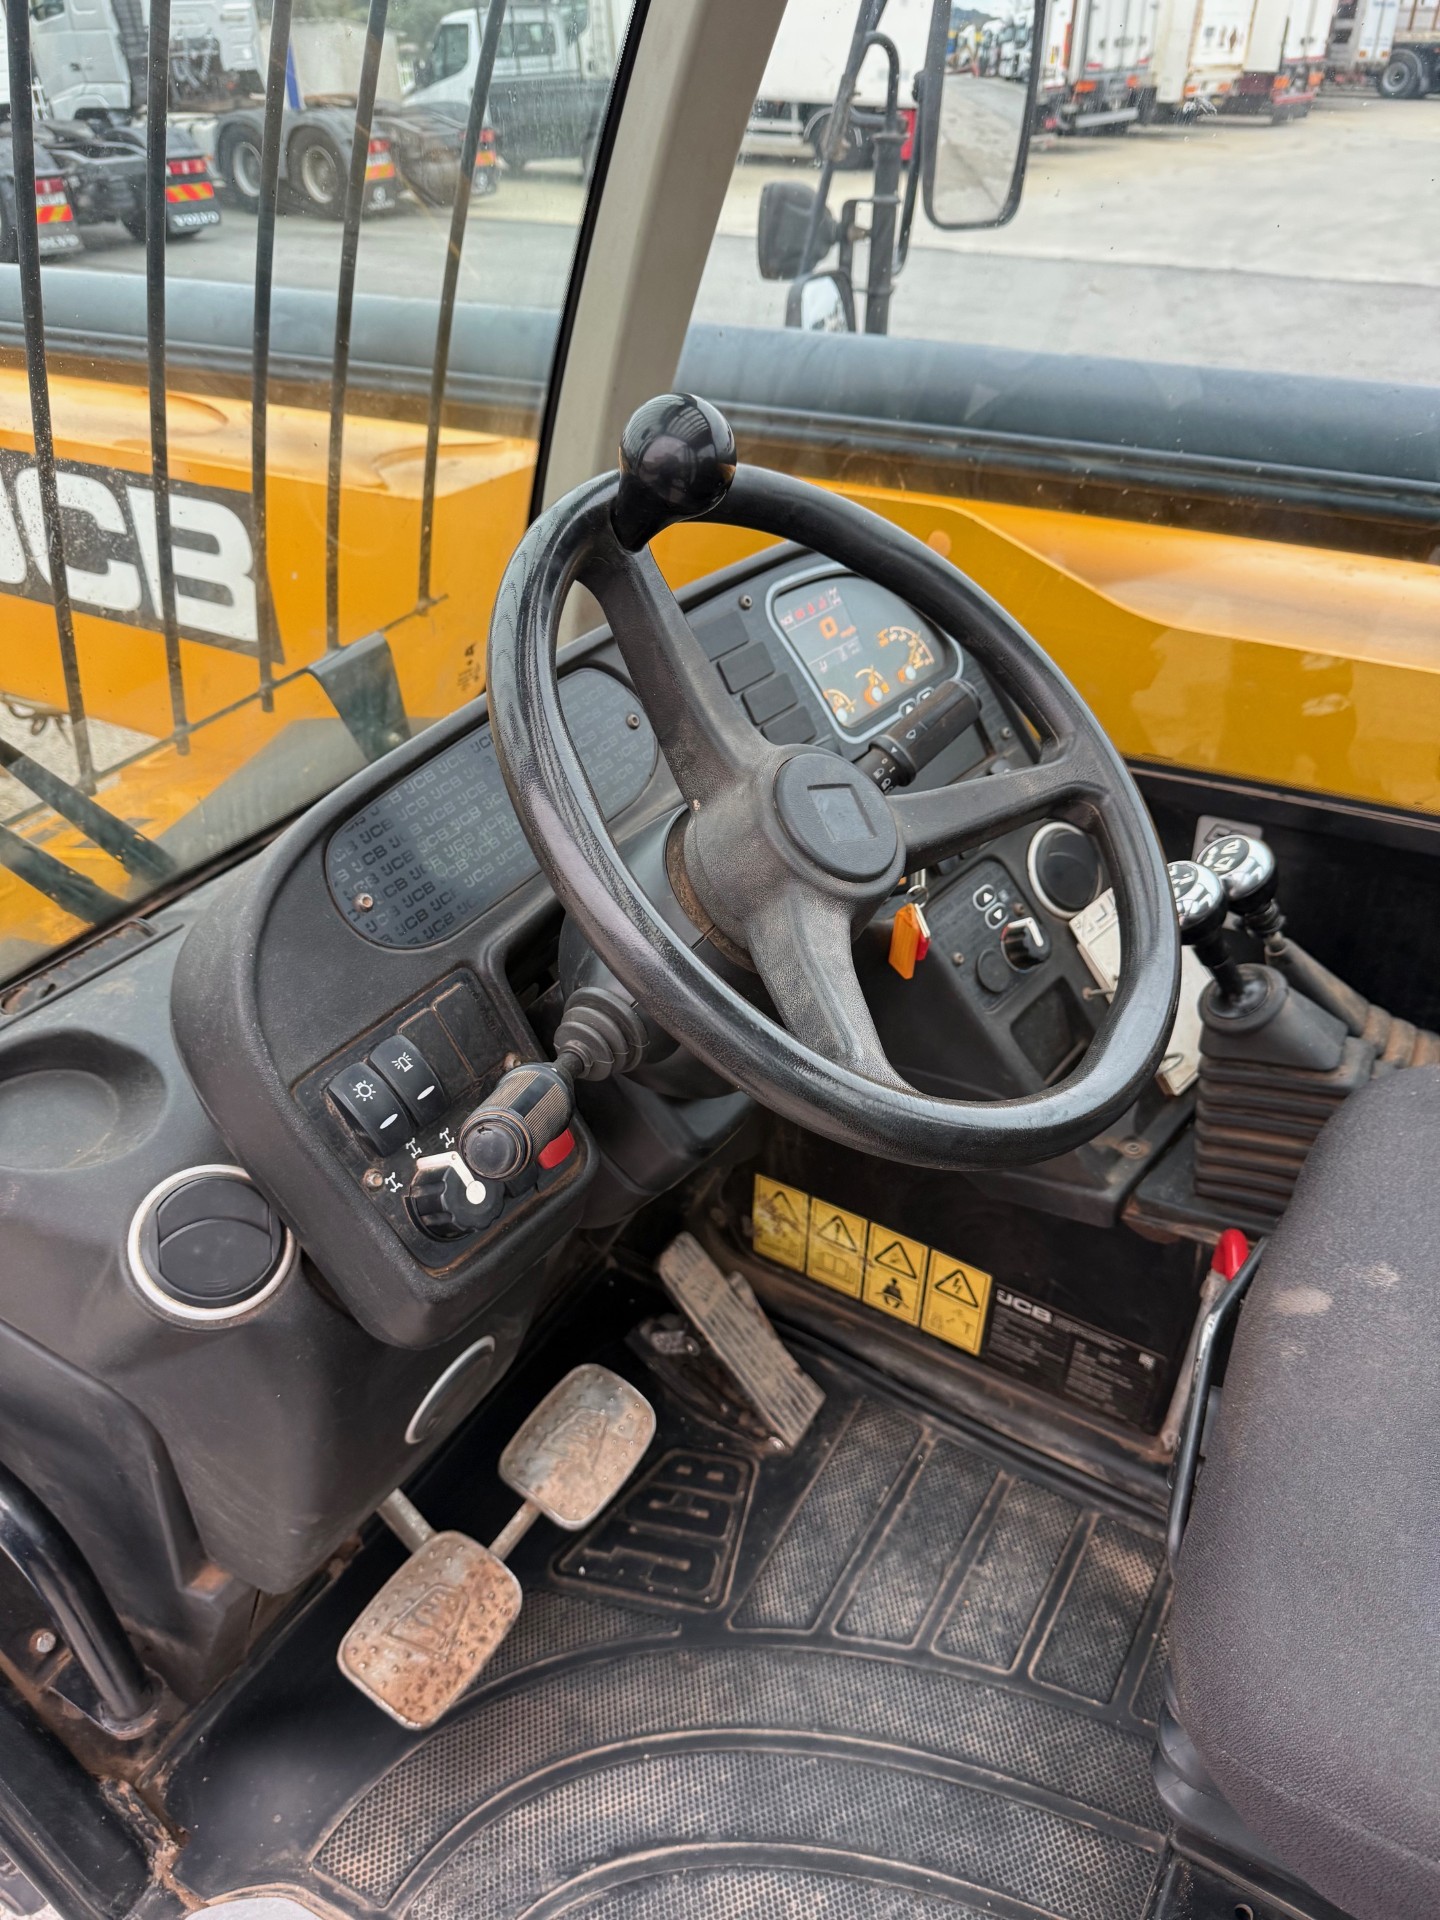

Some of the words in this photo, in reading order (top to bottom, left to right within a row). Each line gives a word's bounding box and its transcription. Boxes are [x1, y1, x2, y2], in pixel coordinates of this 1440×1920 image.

[403, 769, 437, 794] JCB
[469, 734, 494, 753] JC
[351, 844, 388, 874] JCB
[423, 802, 457, 827] JCB
[456, 780, 489, 806] JCB
[359, 816, 395, 845] JCB
[397, 795, 431, 822] JCB
[430, 775, 463, 800] JCB
[380, 849, 416, 877] JCB
[450, 805, 482, 830] JCB
[395, 907, 429, 937] JCB
[464, 861, 495, 888] JCB
[496, 841, 525, 866] JCB
[402, 880, 436, 909] JCB
[422, 910, 455, 940] JCB
[996, 1288, 1053, 1324] JCB
